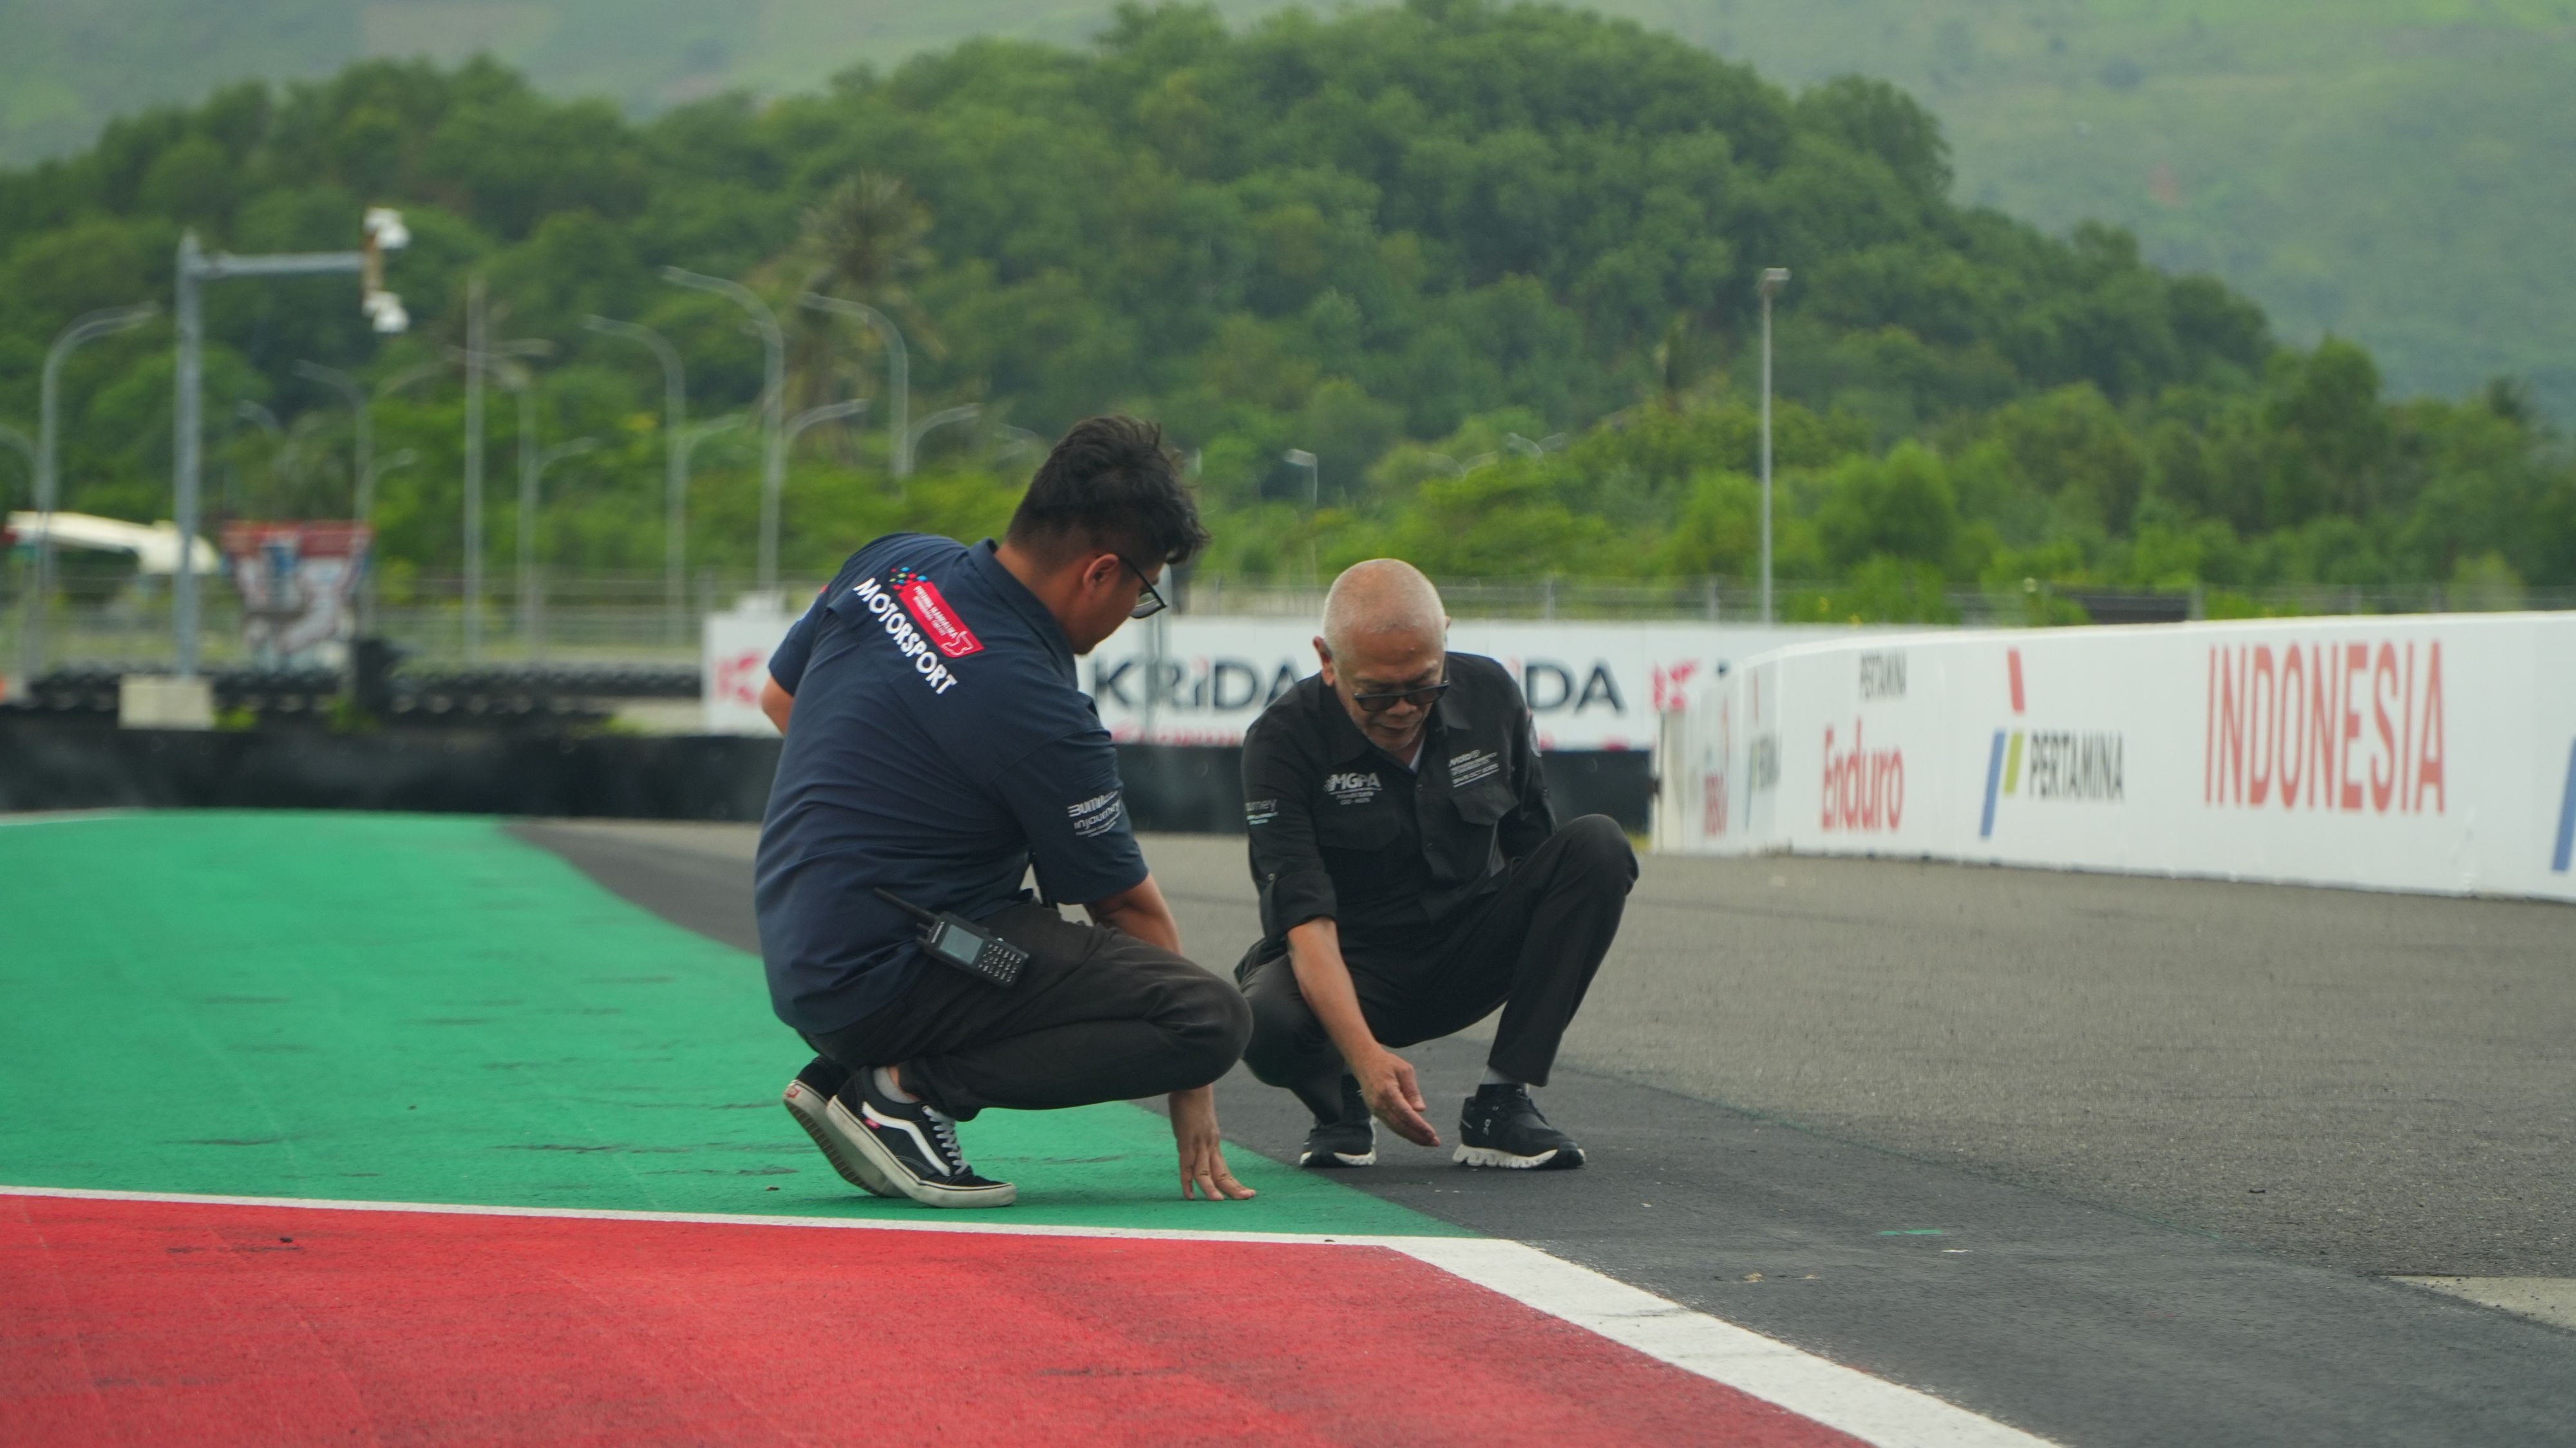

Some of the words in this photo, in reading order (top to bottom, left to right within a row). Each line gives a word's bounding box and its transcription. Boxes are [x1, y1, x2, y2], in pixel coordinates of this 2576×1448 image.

[853, 577, 958, 694] MOTORSPORT
[1325, 772, 1381, 791] MGPA
[1822, 714, 1904, 832] Enduro
[2029, 729, 2123, 801] PERTAMINA
[2204, 638, 2445, 814] INDONESIA
